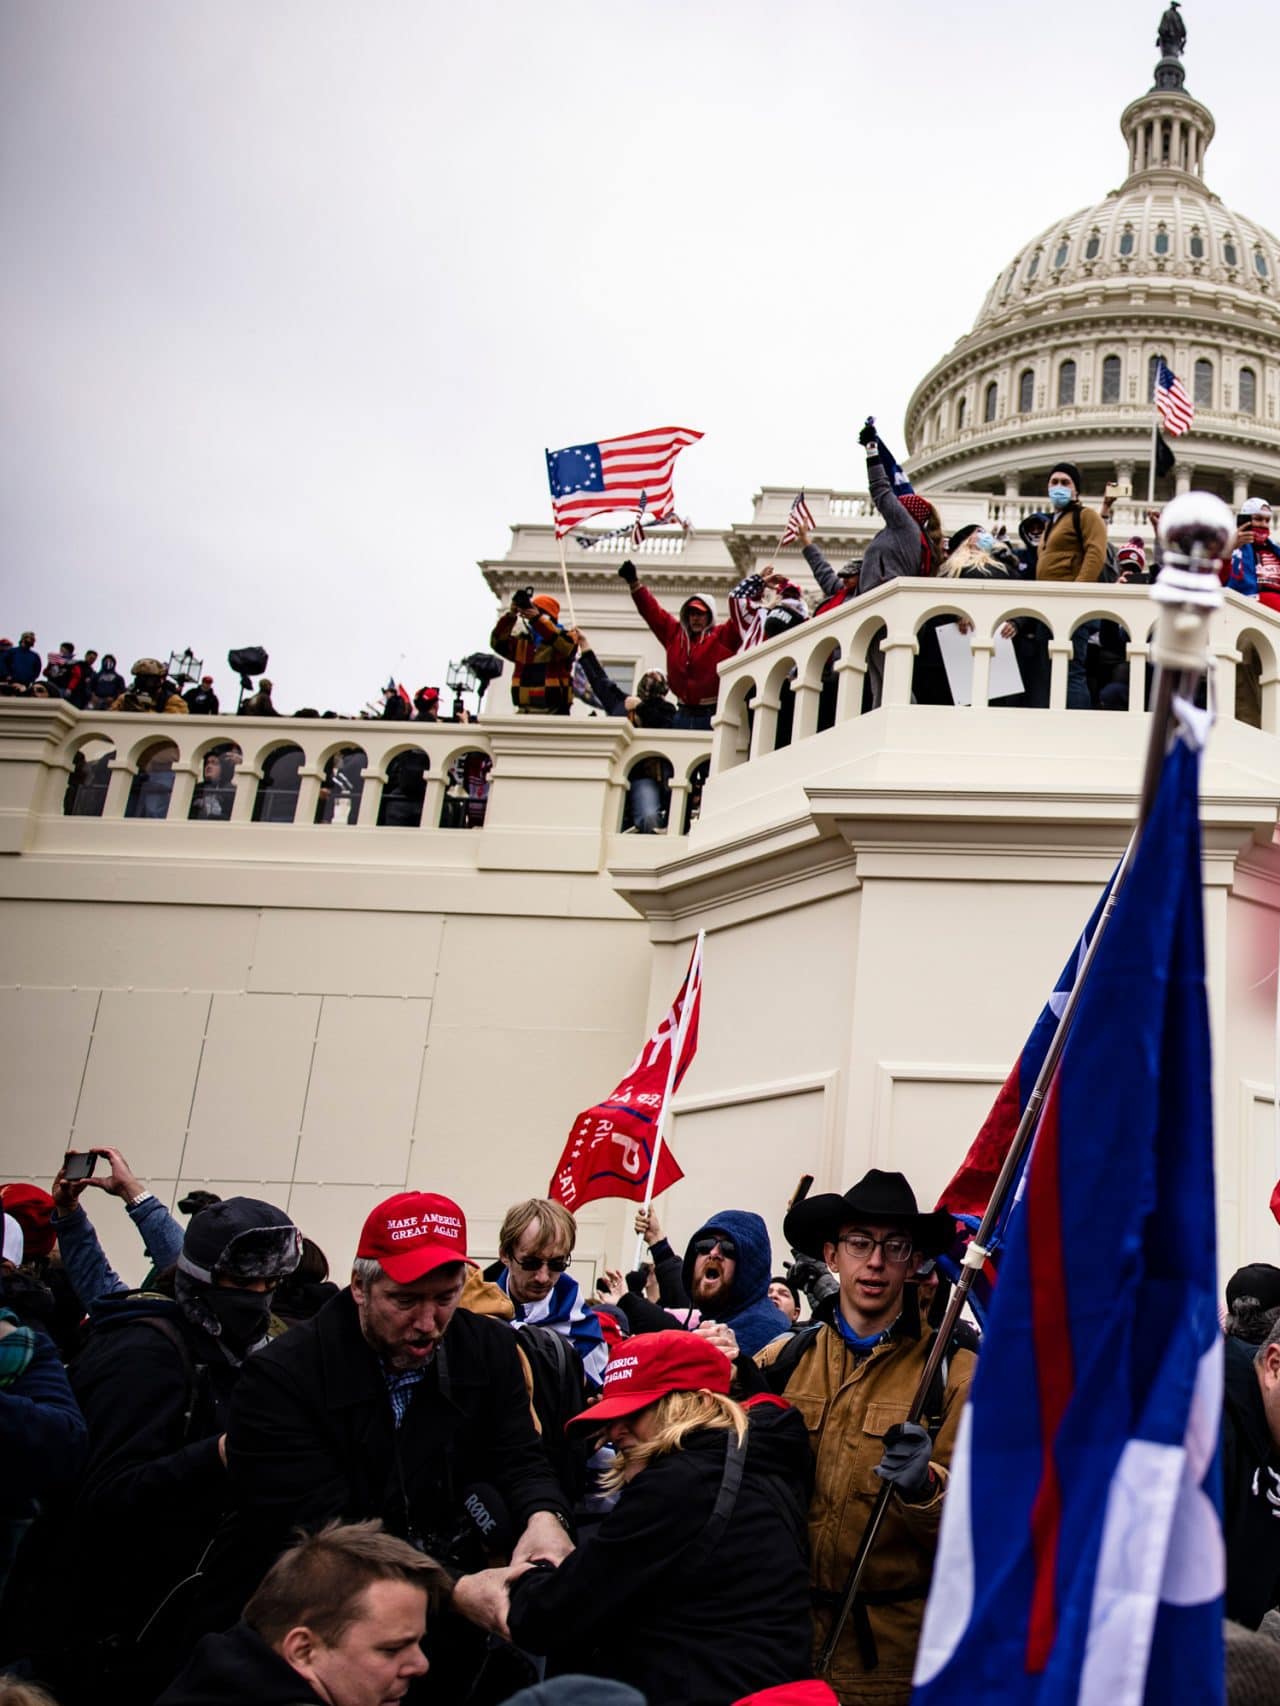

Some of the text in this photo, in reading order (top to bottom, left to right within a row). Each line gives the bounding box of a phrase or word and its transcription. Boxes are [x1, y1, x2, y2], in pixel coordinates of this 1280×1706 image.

[387, 1213, 462, 1230] MAKE AMERICA
[391, 1224, 459, 1241] GREAT AGAIN
[464, 1493, 497, 1536] RØDE
